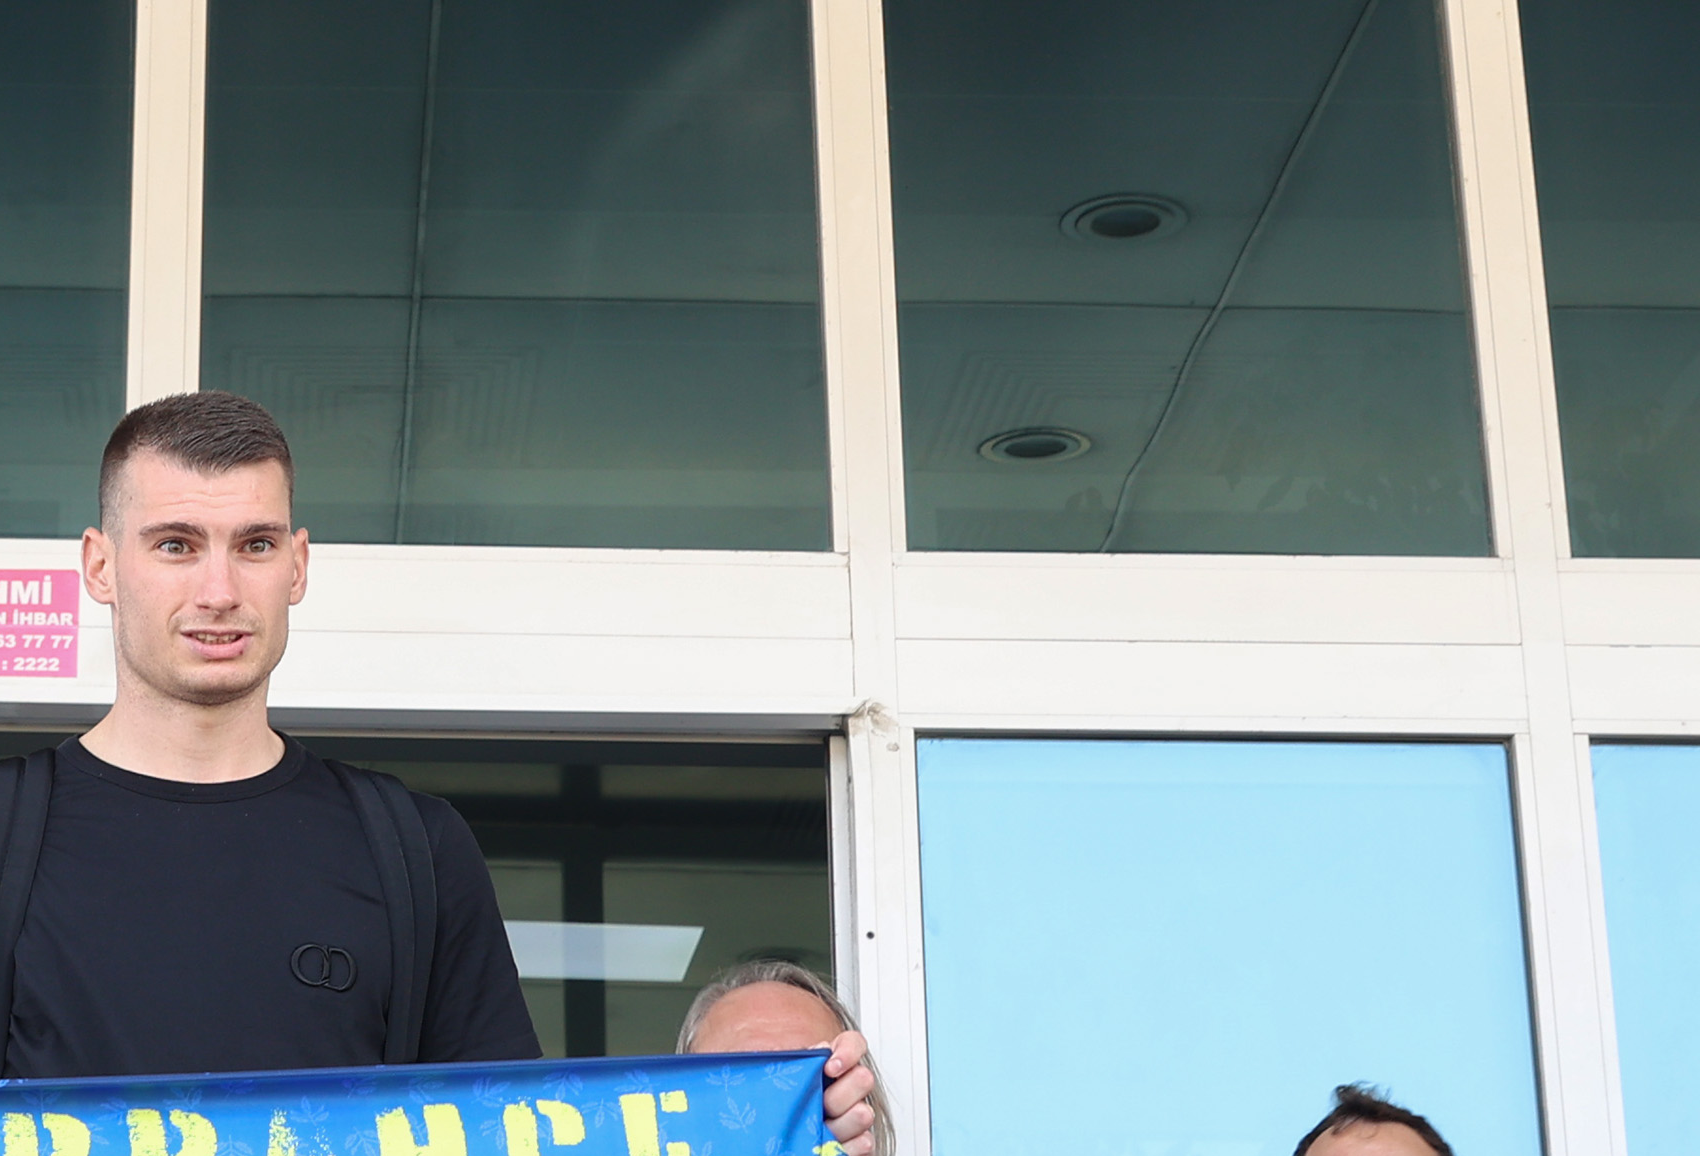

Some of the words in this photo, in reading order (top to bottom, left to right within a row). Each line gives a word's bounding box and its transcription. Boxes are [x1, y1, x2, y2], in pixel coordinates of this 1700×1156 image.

[13, 609, 73, 626] İHBAR
[22, 635, 45, 648] 77
[51, 635, 74, 649] 77
[13, 657, 60, 671] 2222
